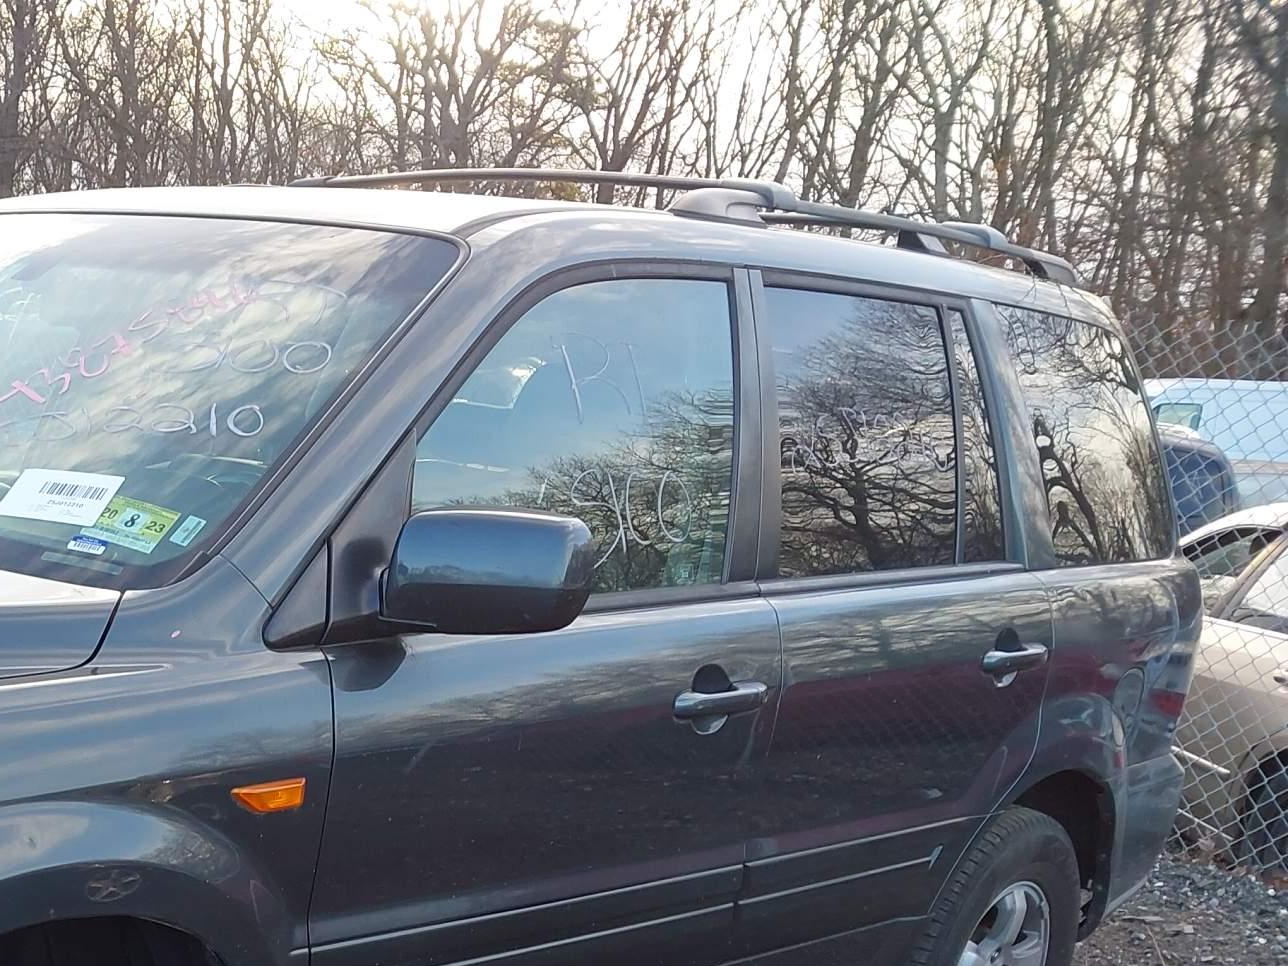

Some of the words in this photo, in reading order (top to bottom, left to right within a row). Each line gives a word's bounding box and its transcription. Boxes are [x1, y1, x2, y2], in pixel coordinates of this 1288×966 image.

[101, 507, 119, 520] 20
[124, 513, 141, 528] 8
[144, 521, 166, 533] 23
